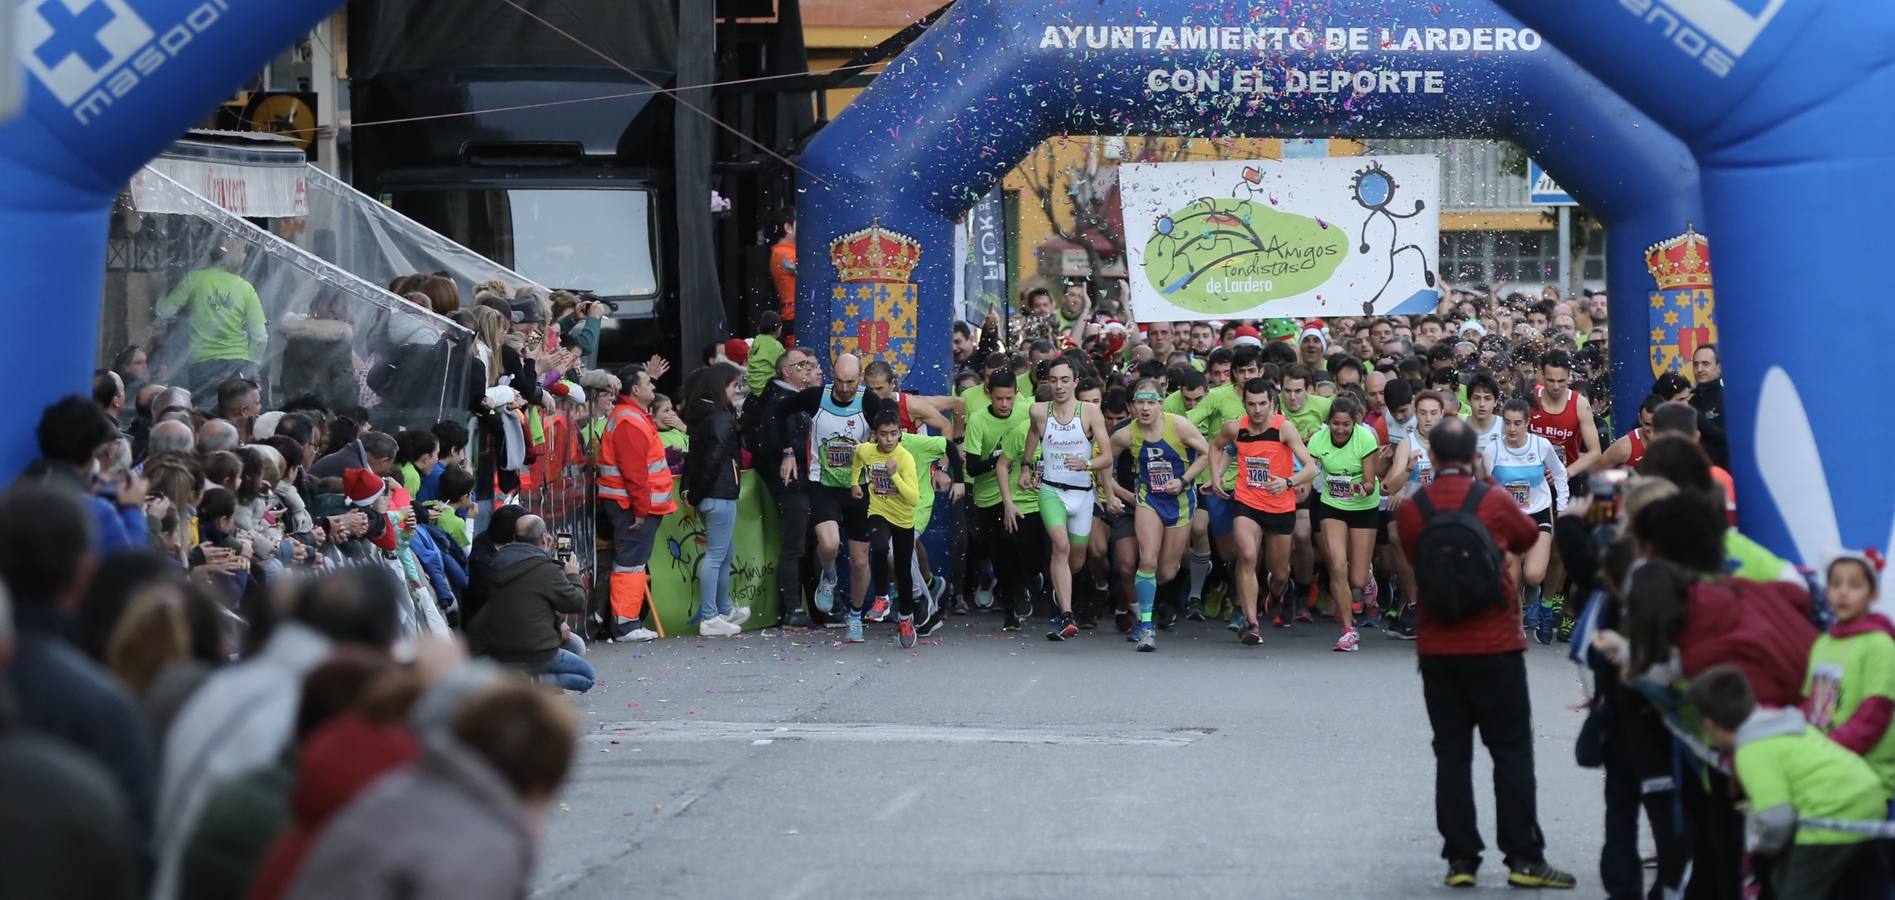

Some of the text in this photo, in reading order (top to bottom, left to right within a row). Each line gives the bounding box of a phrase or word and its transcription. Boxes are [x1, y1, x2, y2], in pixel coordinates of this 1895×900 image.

[1039, 25, 1542, 51] AYUNTAMIENTO DE LARDERO
[1148, 69, 1444, 93] CON EL DEPORTE
[1266, 235, 1338, 269] Amigos
[1221, 253, 1300, 277] fondistas
[1205, 277, 1273, 294] de Lardero
[1050, 422, 1076, 431] TEJADA
[1530, 423, 1543, 434] La
[1546, 426, 1574, 439] Rioja
[1248, 469, 1268, 482] 1280
